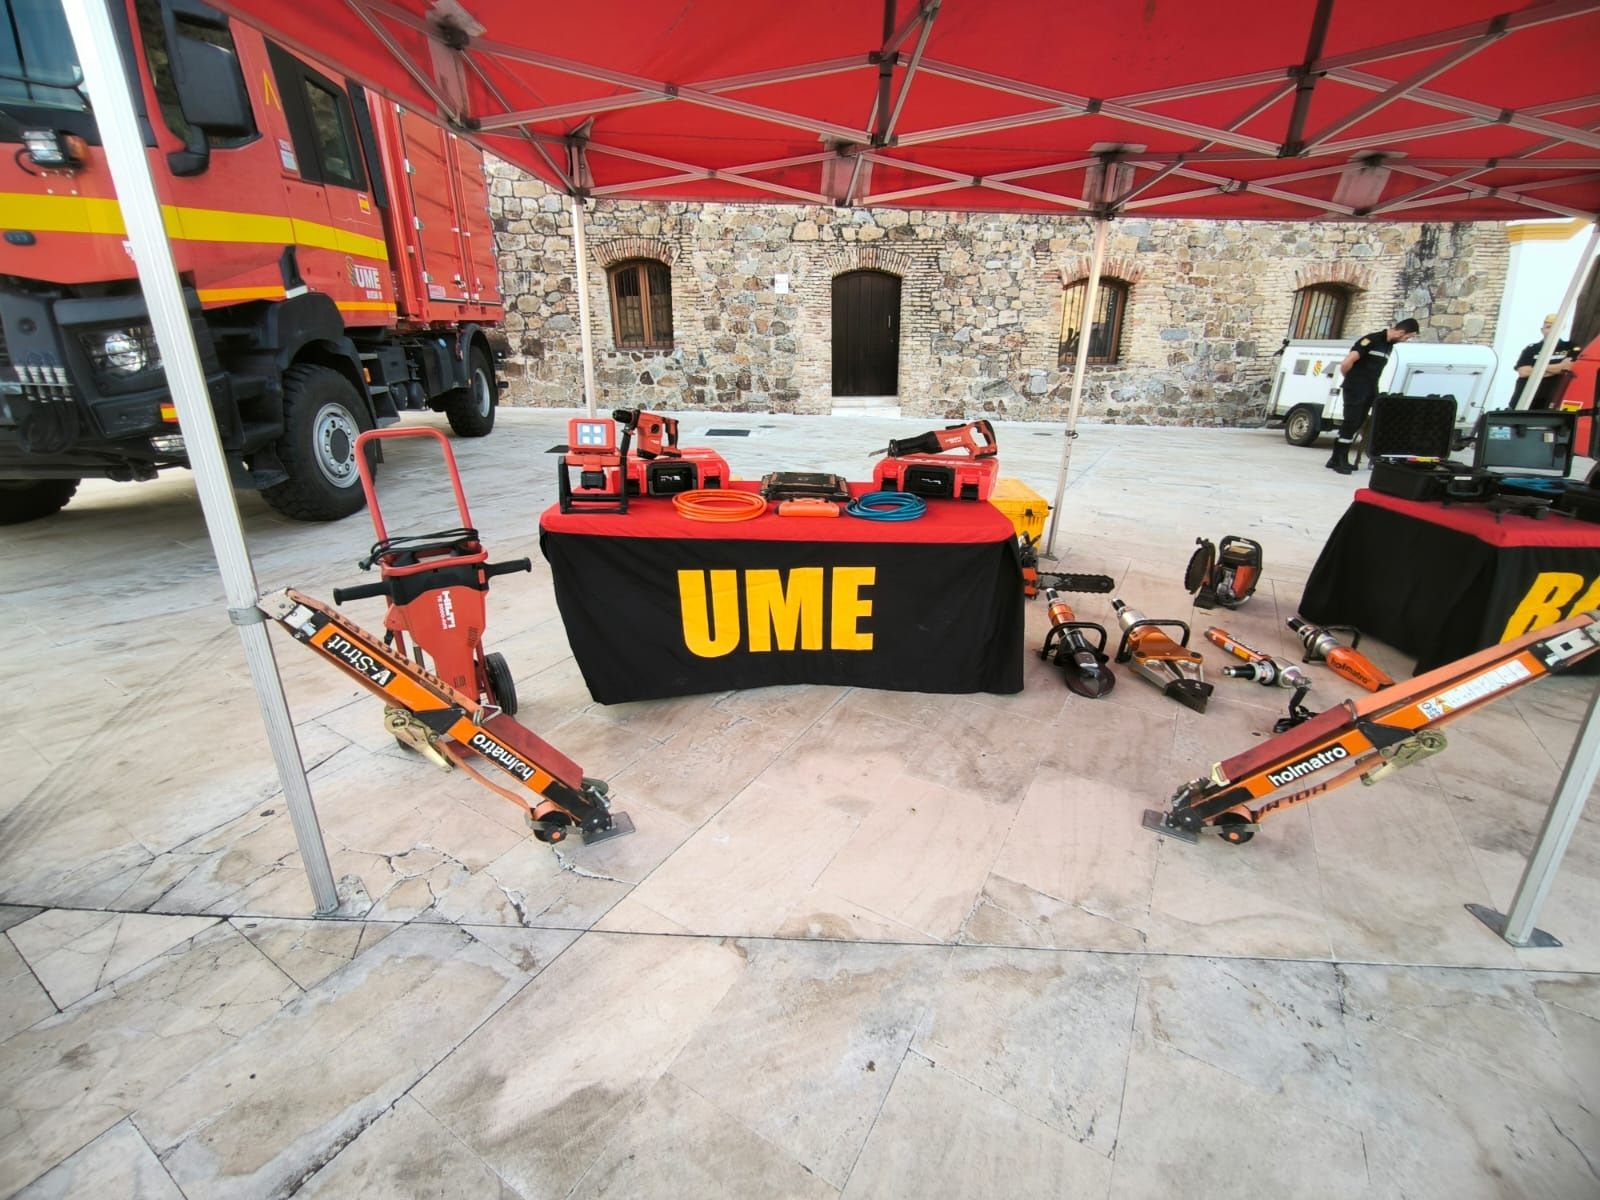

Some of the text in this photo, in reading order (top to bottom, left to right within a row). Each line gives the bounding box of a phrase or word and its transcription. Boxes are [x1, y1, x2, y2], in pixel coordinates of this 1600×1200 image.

[354, 266, 381, 290] UME
[442, 590, 456, 628] HILTI
[677, 566, 876, 658] UME
[327, 634, 390, 686] V-Strut
[473, 733, 535, 781] holmatro
[1268, 746, 1347, 787] holmatro
